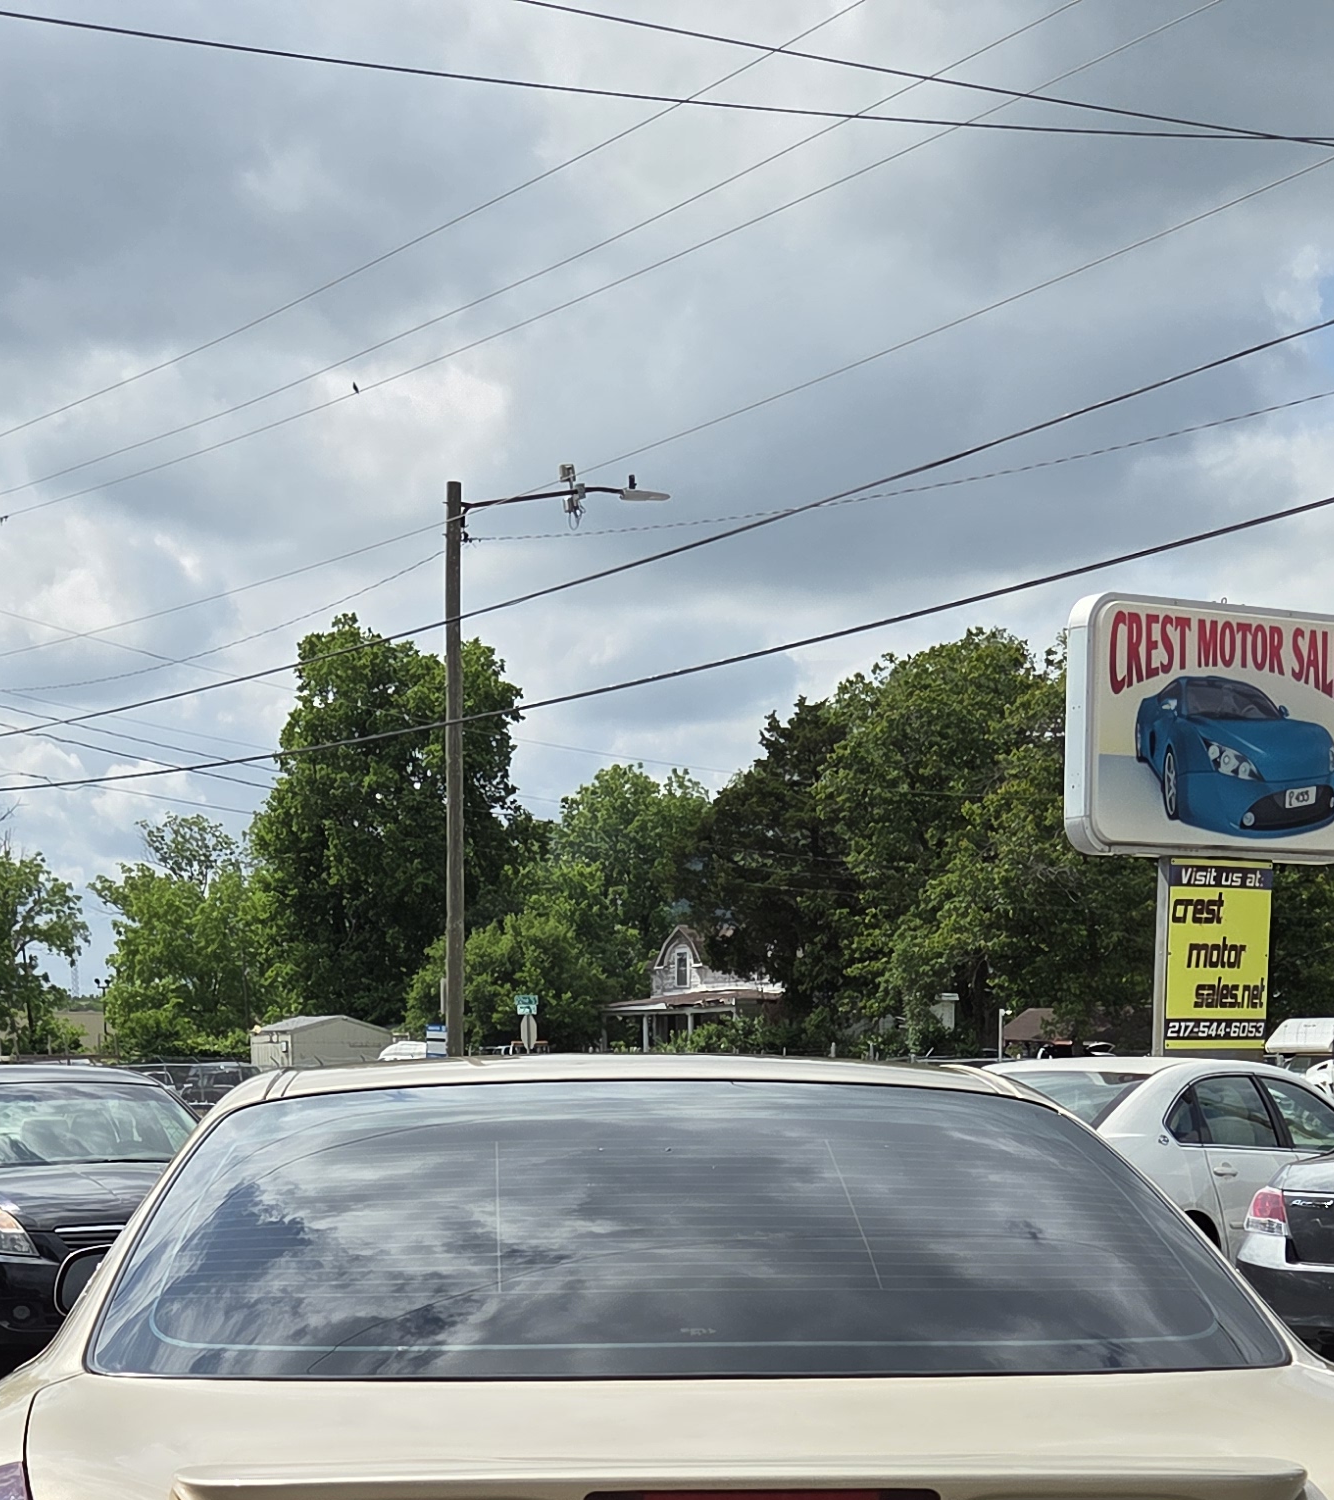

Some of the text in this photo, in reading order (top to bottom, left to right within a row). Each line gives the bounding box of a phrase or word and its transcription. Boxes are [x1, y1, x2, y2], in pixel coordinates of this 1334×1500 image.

[1109, 610, 1192, 695] CREST
[1197, 618, 1285, 677] MOTOR
[1181, 867, 1217, 885] Visit
[1221, 872, 1243, 887] us
[1171, 892, 1224, 925] crest
[1186, 936, 1247, 969] motor
[1193, 976, 1265, 1009] sales.net
[1167, 1021, 1265, 1037] 217-544-6053
